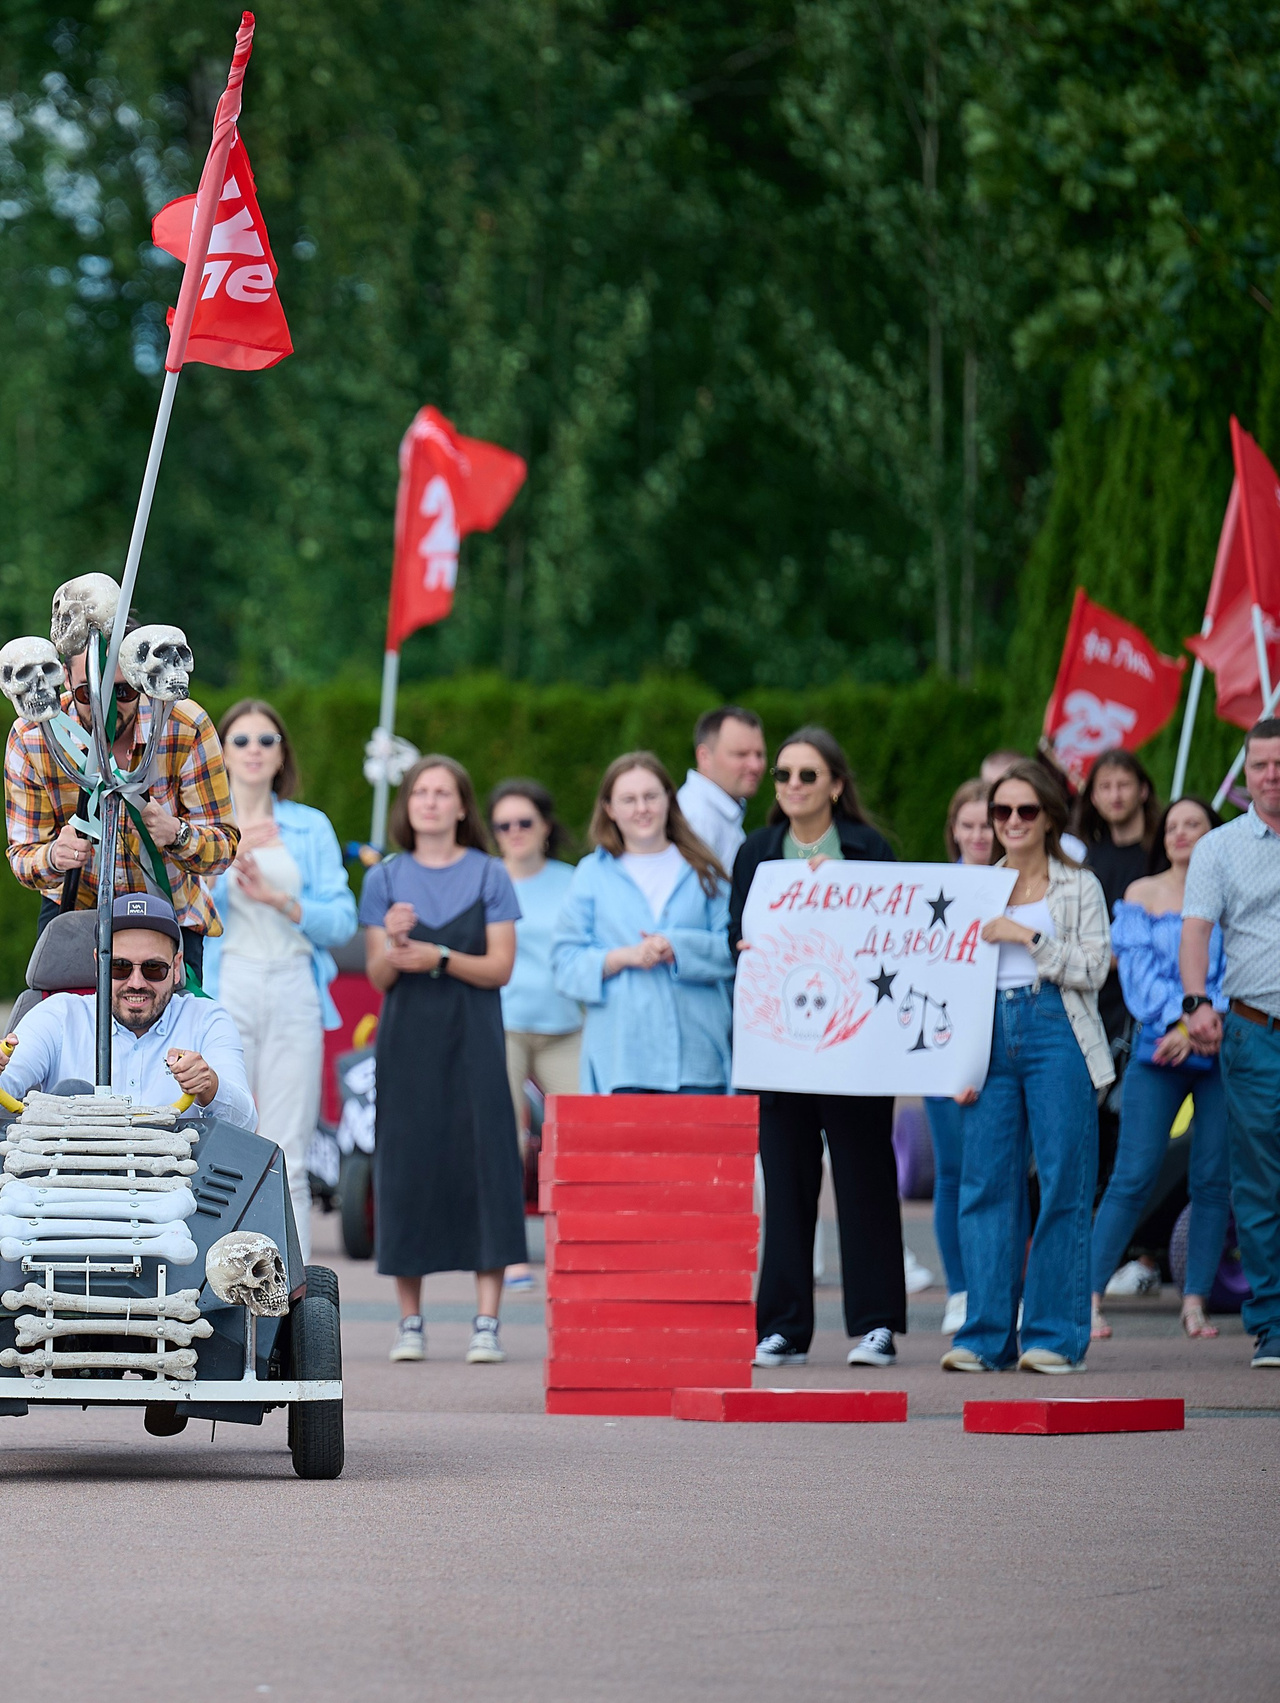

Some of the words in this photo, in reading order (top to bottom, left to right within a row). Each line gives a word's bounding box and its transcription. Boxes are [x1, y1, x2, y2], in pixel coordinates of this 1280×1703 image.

[1053, 688, 1138, 758] 25
[768, 880, 922, 917] АДВОКАТ
[854, 917, 982, 966] ДЬЯВОЛА
